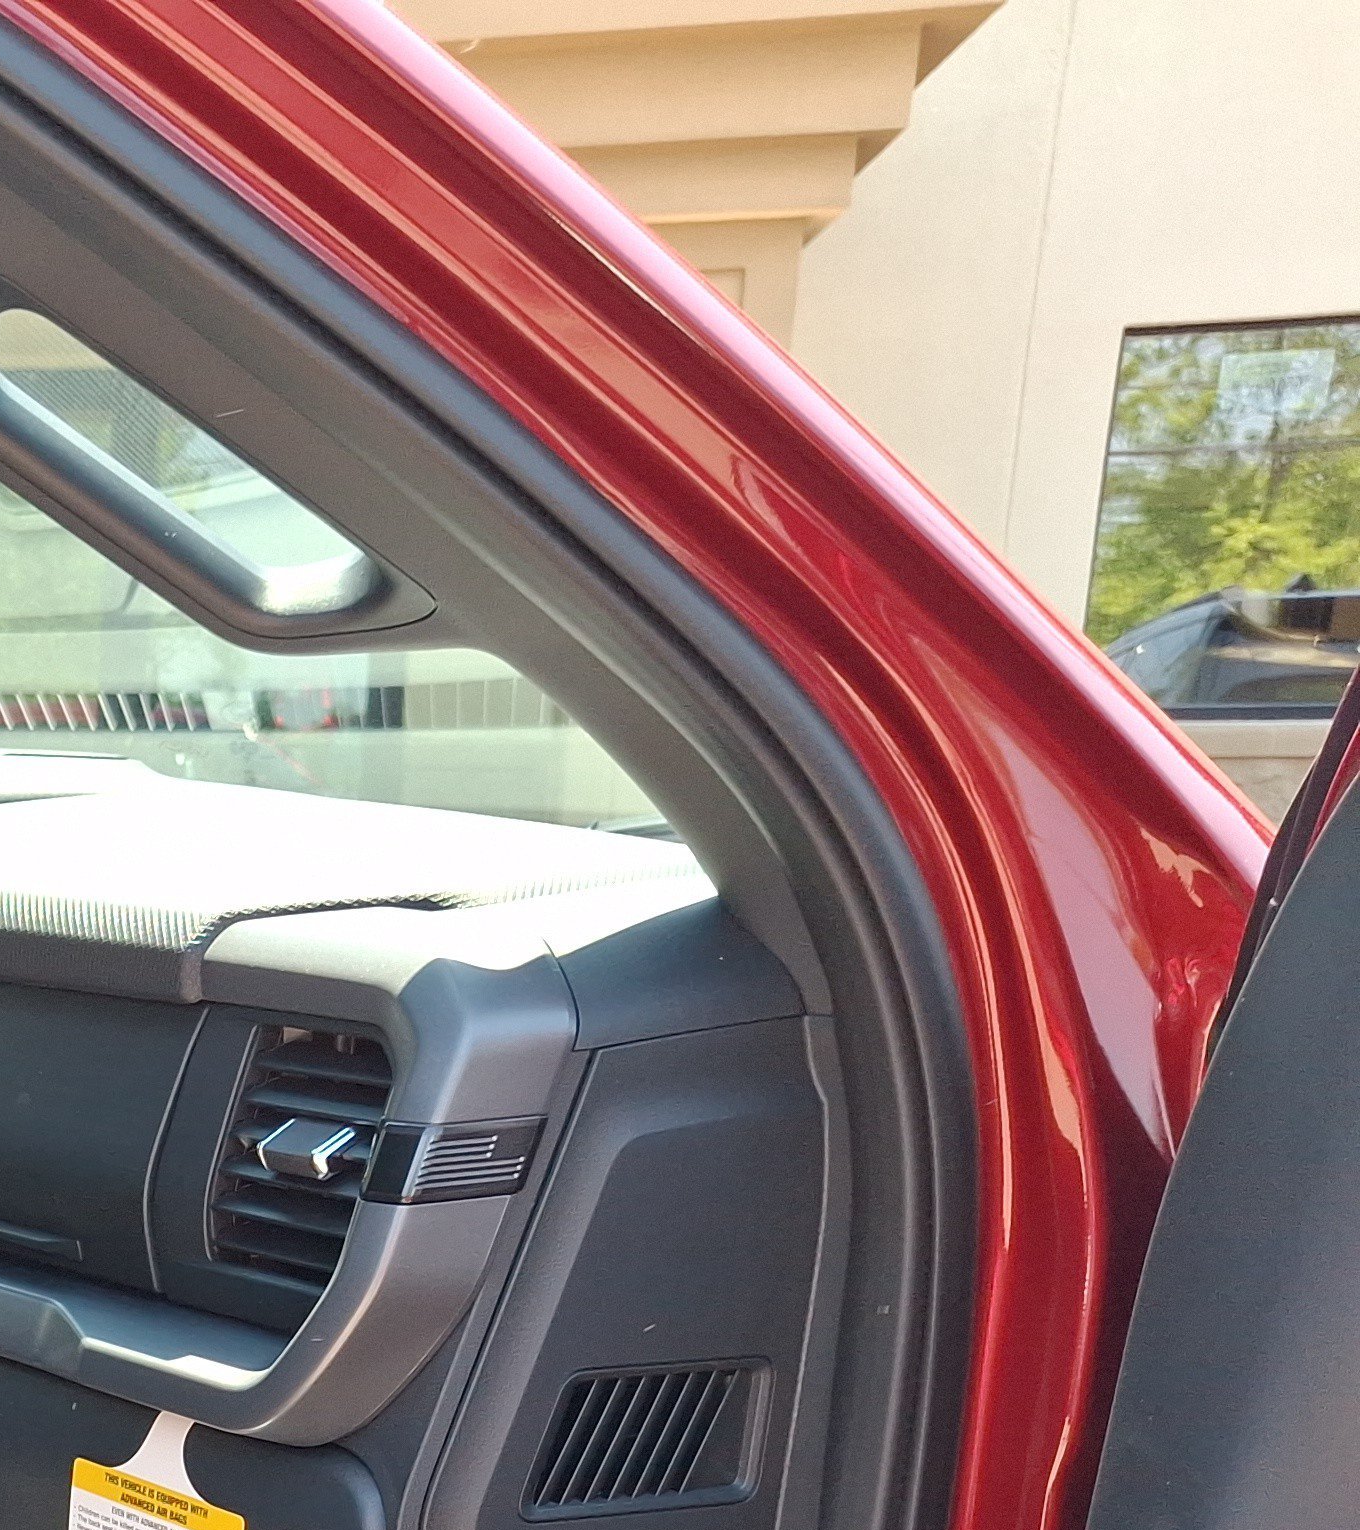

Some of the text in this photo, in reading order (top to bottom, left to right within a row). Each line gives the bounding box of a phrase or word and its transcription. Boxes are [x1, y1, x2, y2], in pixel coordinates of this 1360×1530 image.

[105, 1473, 208, 1517] THIS VEHICLE IS EQUIPPED WITH
[121, 1493, 186, 1524] ADVANCED AIR BAGS
